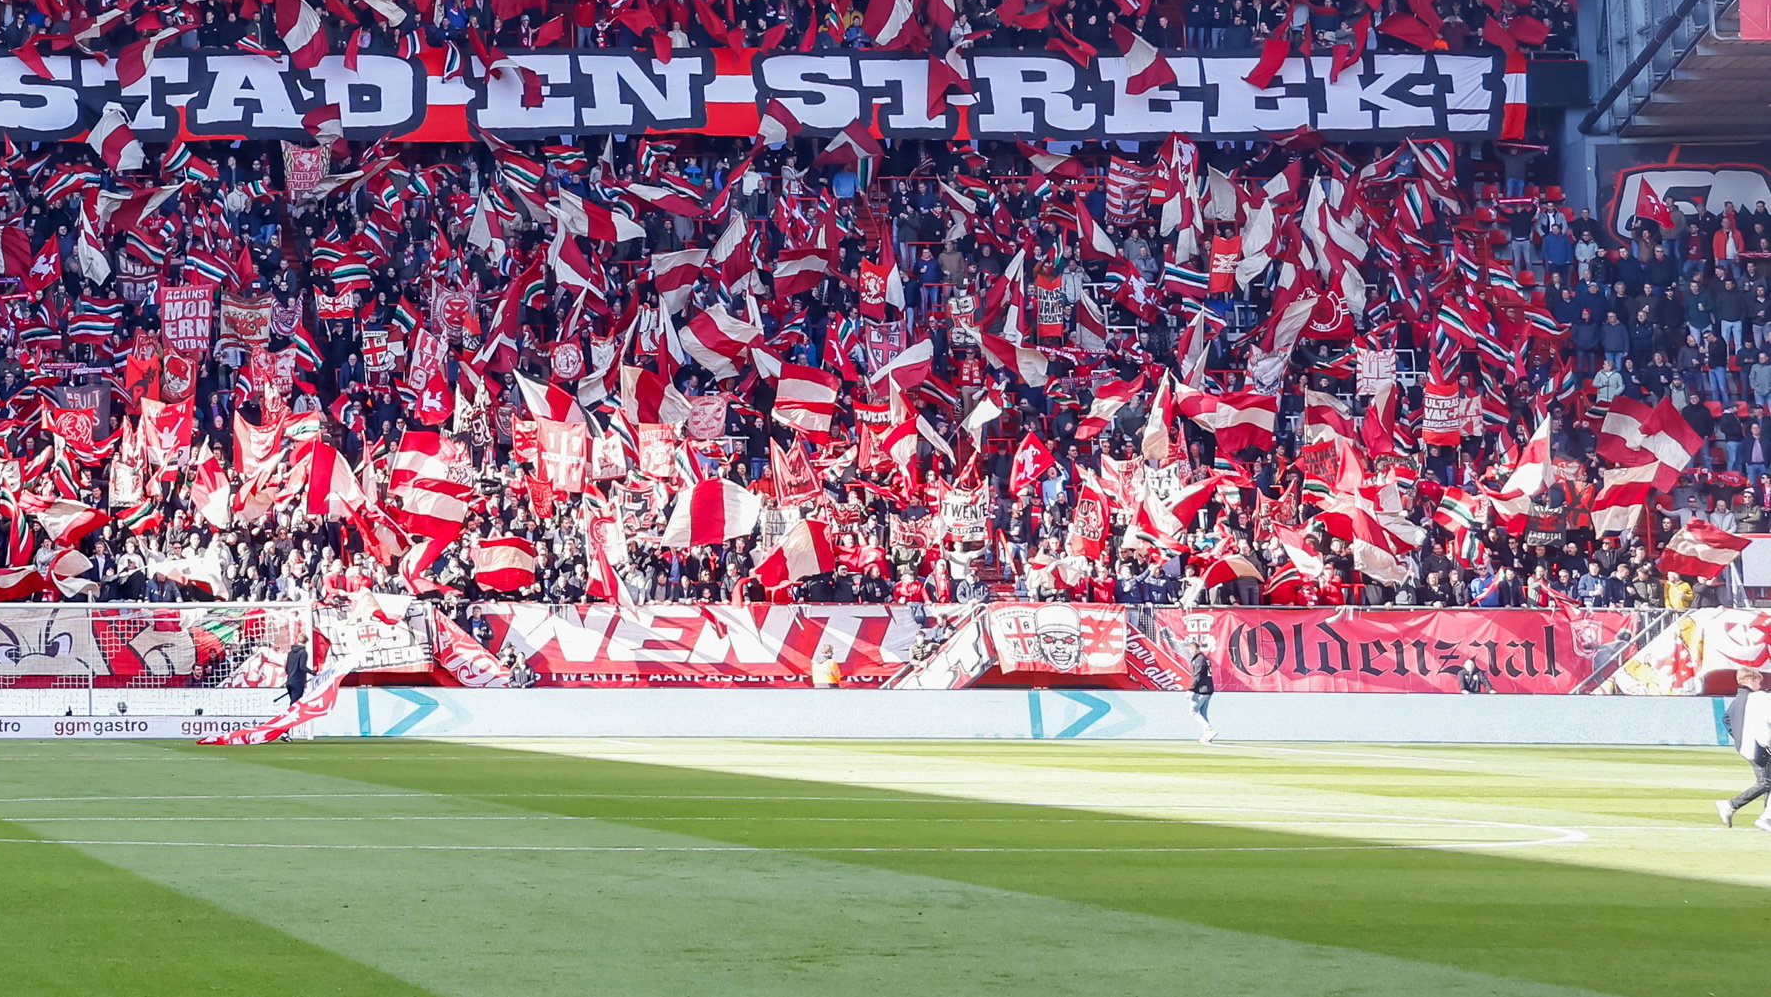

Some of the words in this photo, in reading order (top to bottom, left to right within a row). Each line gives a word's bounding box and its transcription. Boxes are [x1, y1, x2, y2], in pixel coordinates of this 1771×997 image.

[473, 54, 703, 129] EN
[762, 54, 1495, 134] STREEK!
[165, 288, 210, 300] AGAINST
[164, 301, 210, 320] MOD
[950, 298, 976, 314] 19
[165, 319, 210, 337] ERN
[171, 337, 210, 350] OOTBAL
[1425, 397, 1460, 409] ULTRAS
[1425, 407, 1459, 421] VAK-P
[942, 502, 987, 520] TWENTE
[475, 603, 950, 664] WENT
[1228, 622, 1564, 679] Oldenzaal
